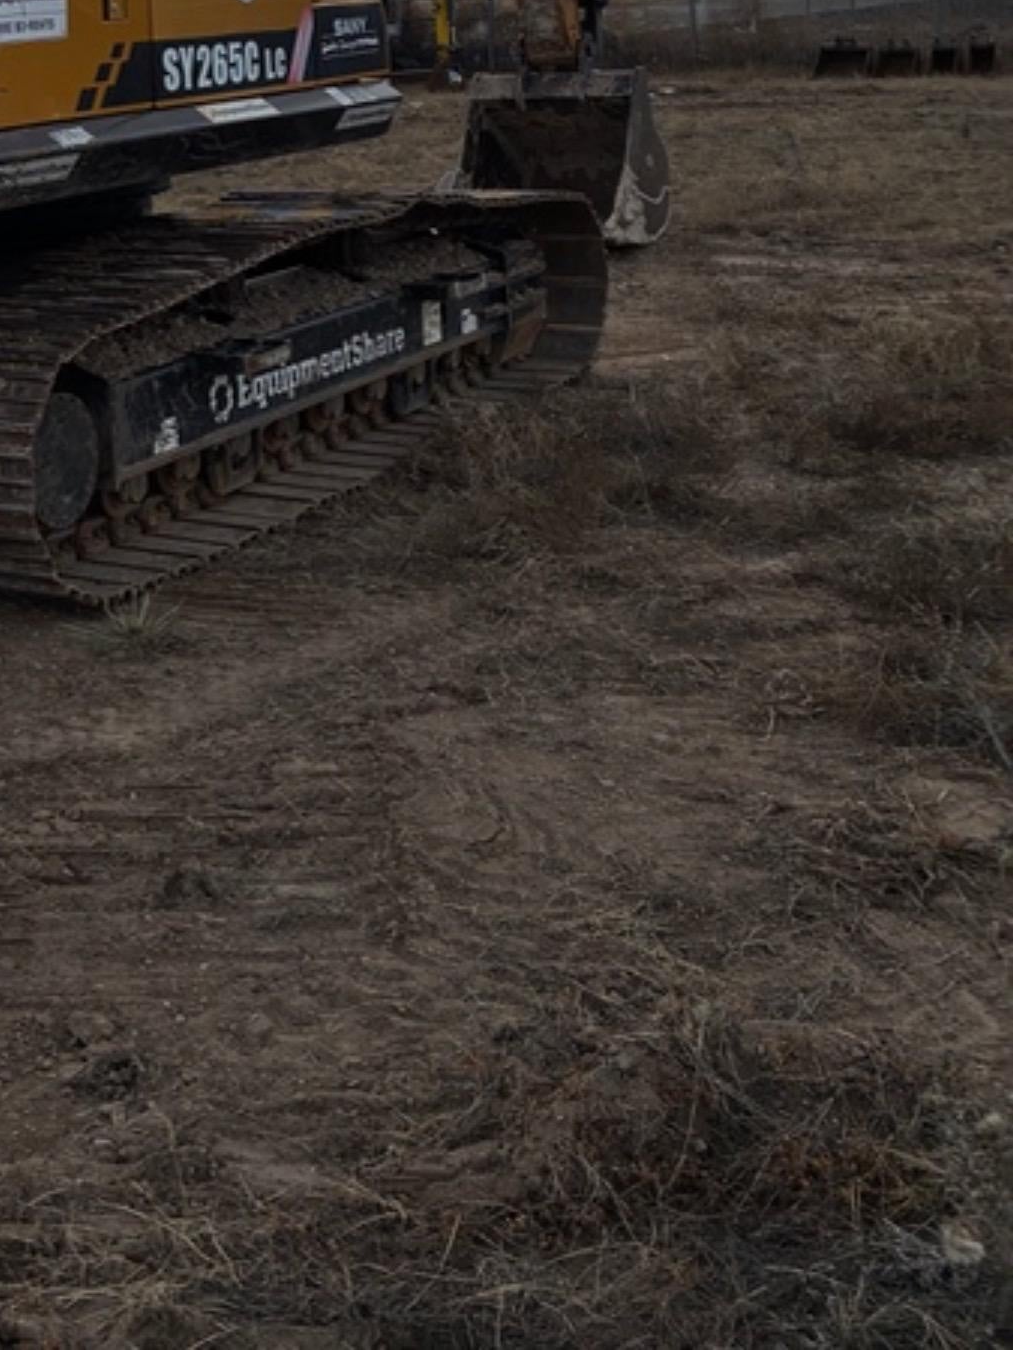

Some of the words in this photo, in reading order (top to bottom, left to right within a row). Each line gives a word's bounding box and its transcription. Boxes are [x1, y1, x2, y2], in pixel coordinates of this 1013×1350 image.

[162, 40, 260, 92] SY265C
[264, 47, 287, 80] LC
[236, 327, 406, 410] EquipmentShare
